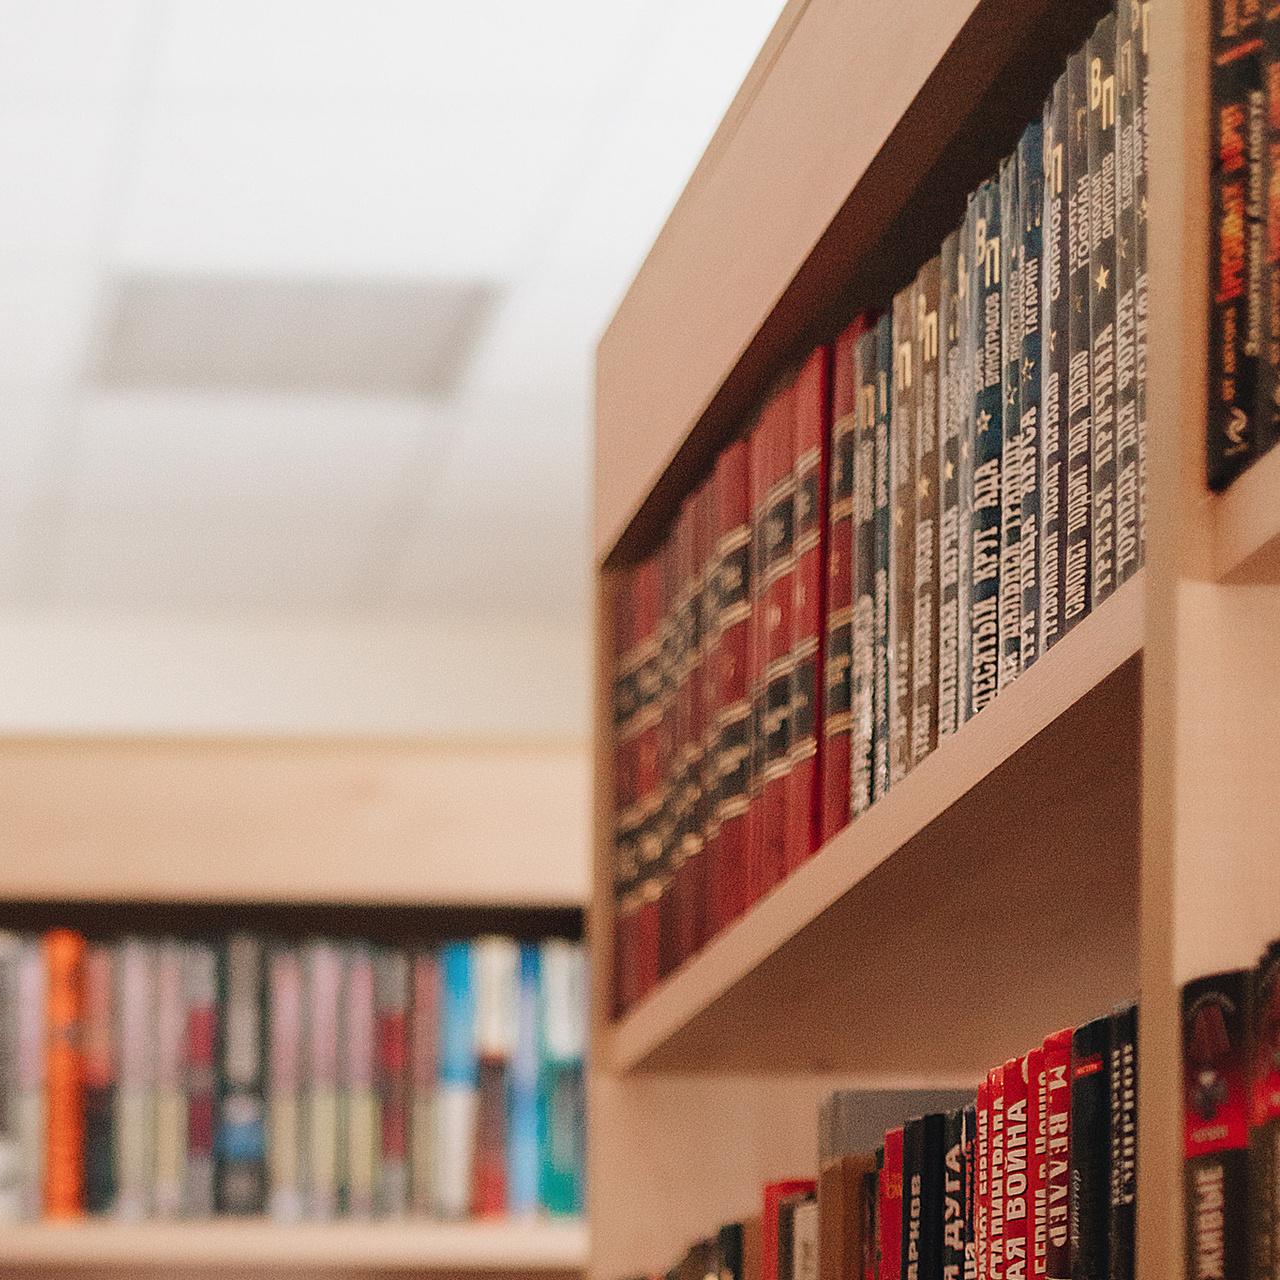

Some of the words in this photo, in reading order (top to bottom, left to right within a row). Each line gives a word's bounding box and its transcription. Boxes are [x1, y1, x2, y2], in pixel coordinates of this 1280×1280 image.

[1078, 173, 1090, 269] ГОФМАН
[1102, 152, 1114, 239] ДМИТРИЕВ
[1025, 258, 1038, 335] ГАГАРИН
[1050, 198, 1061, 301] СМИРНОВ
[985, 292, 1000, 388] ВИНОГРАДОВ
[1068, 350, 1091, 416] ЦЕЛЬЮ
[1116, 287, 1134, 390] ФЮРЕРА
[1068, 416, 1091, 460] НАД
[1094, 323, 1113, 471] ПРИЧИНА
[1118, 399, 1137, 456] ДЛЯ
[974, 459, 1002, 511] АДА
[1068, 464, 1091, 536] ПОДБИТ
[1117, 461, 1137, 571] ТОРПЕДА
[974, 526, 999, 585] КРУГ
[1066, 539, 1087, 620] САМОЛЕТ
[1094, 482, 1113, 596] ТРЕТЬЯ
[971, 595, 998, 708] ДЕСЯТЫЙ
[1047, 1064, 1068, 1104] М.
[942, 1143, 965, 1251] ДУГА
[1003, 1098, 1027, 1221] ВОЙНА
[1046, 1111, 1069, 1248] ВЕЛЛЕР
[1197, 1166, 1224, 1280] ЖИВЫЕ
